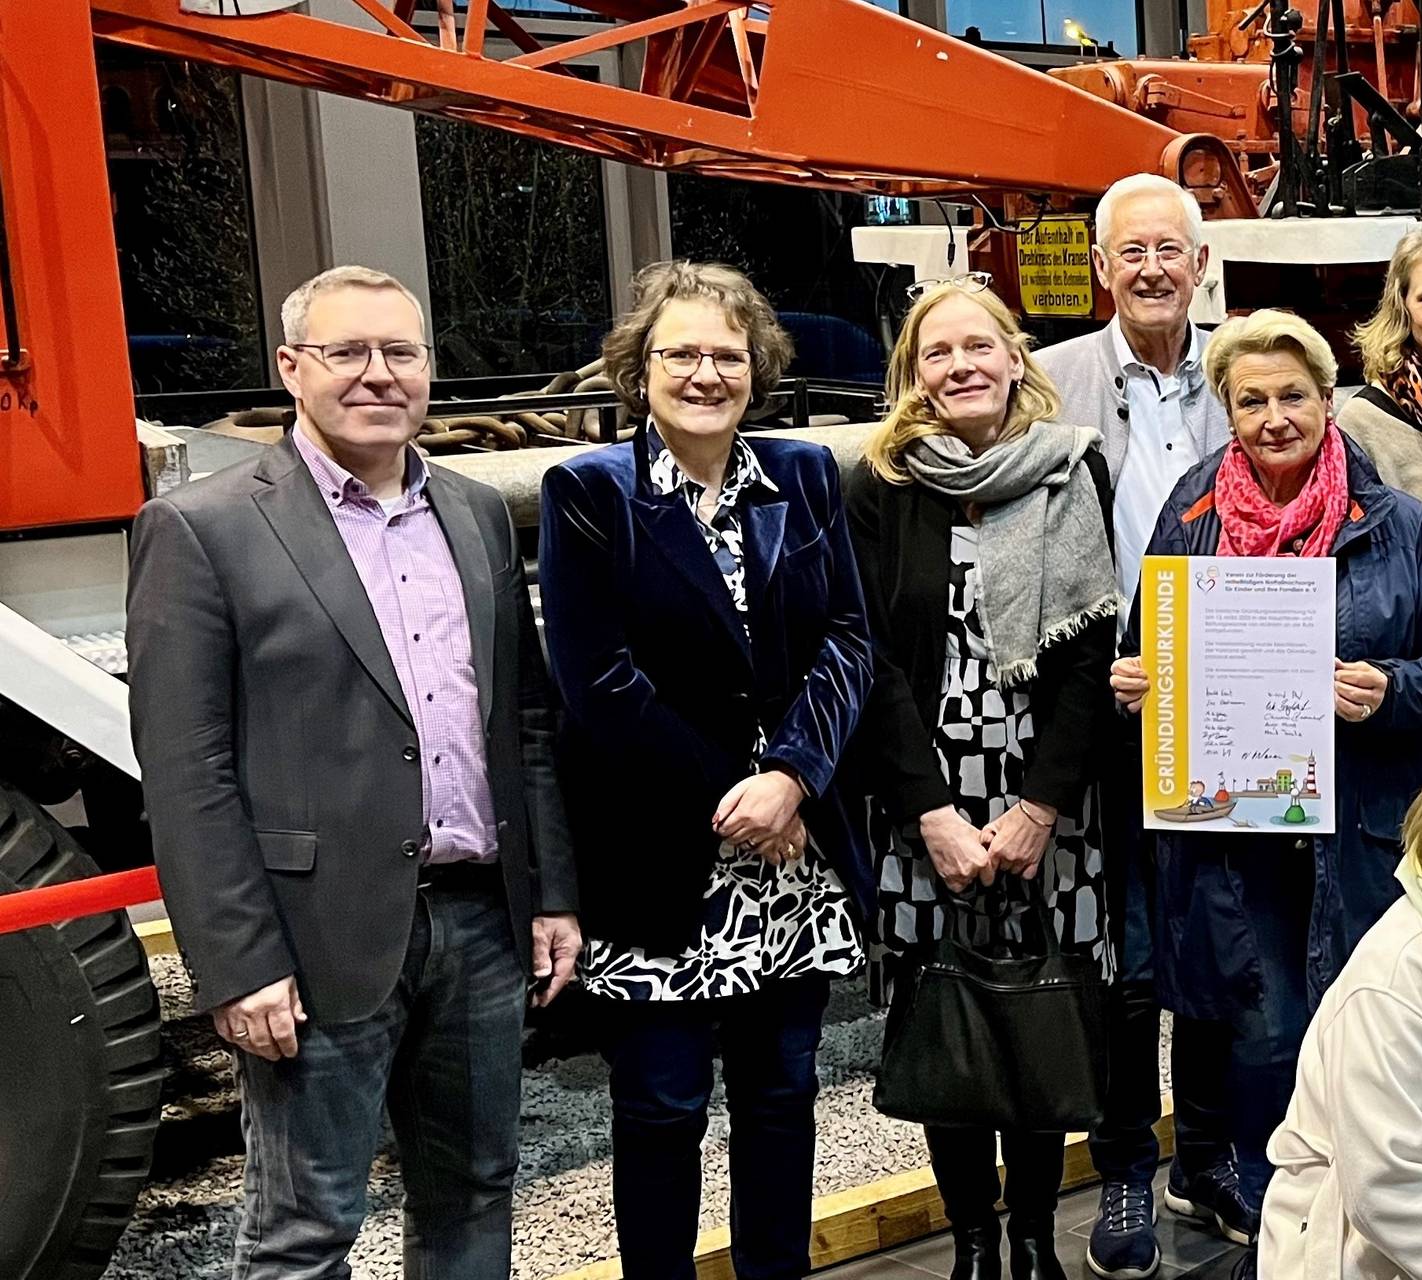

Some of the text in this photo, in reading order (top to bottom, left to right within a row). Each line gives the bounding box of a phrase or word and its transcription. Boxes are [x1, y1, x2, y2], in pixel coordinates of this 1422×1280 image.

[1035, 226, 1073, 245] Aufenthalt
[1062, 247, 1089, 266] Kranes
[1032, 289, 1082, 307] verboten.
[1155, 570, 1175, 795] GRÜNDUNGSURKUNDE
